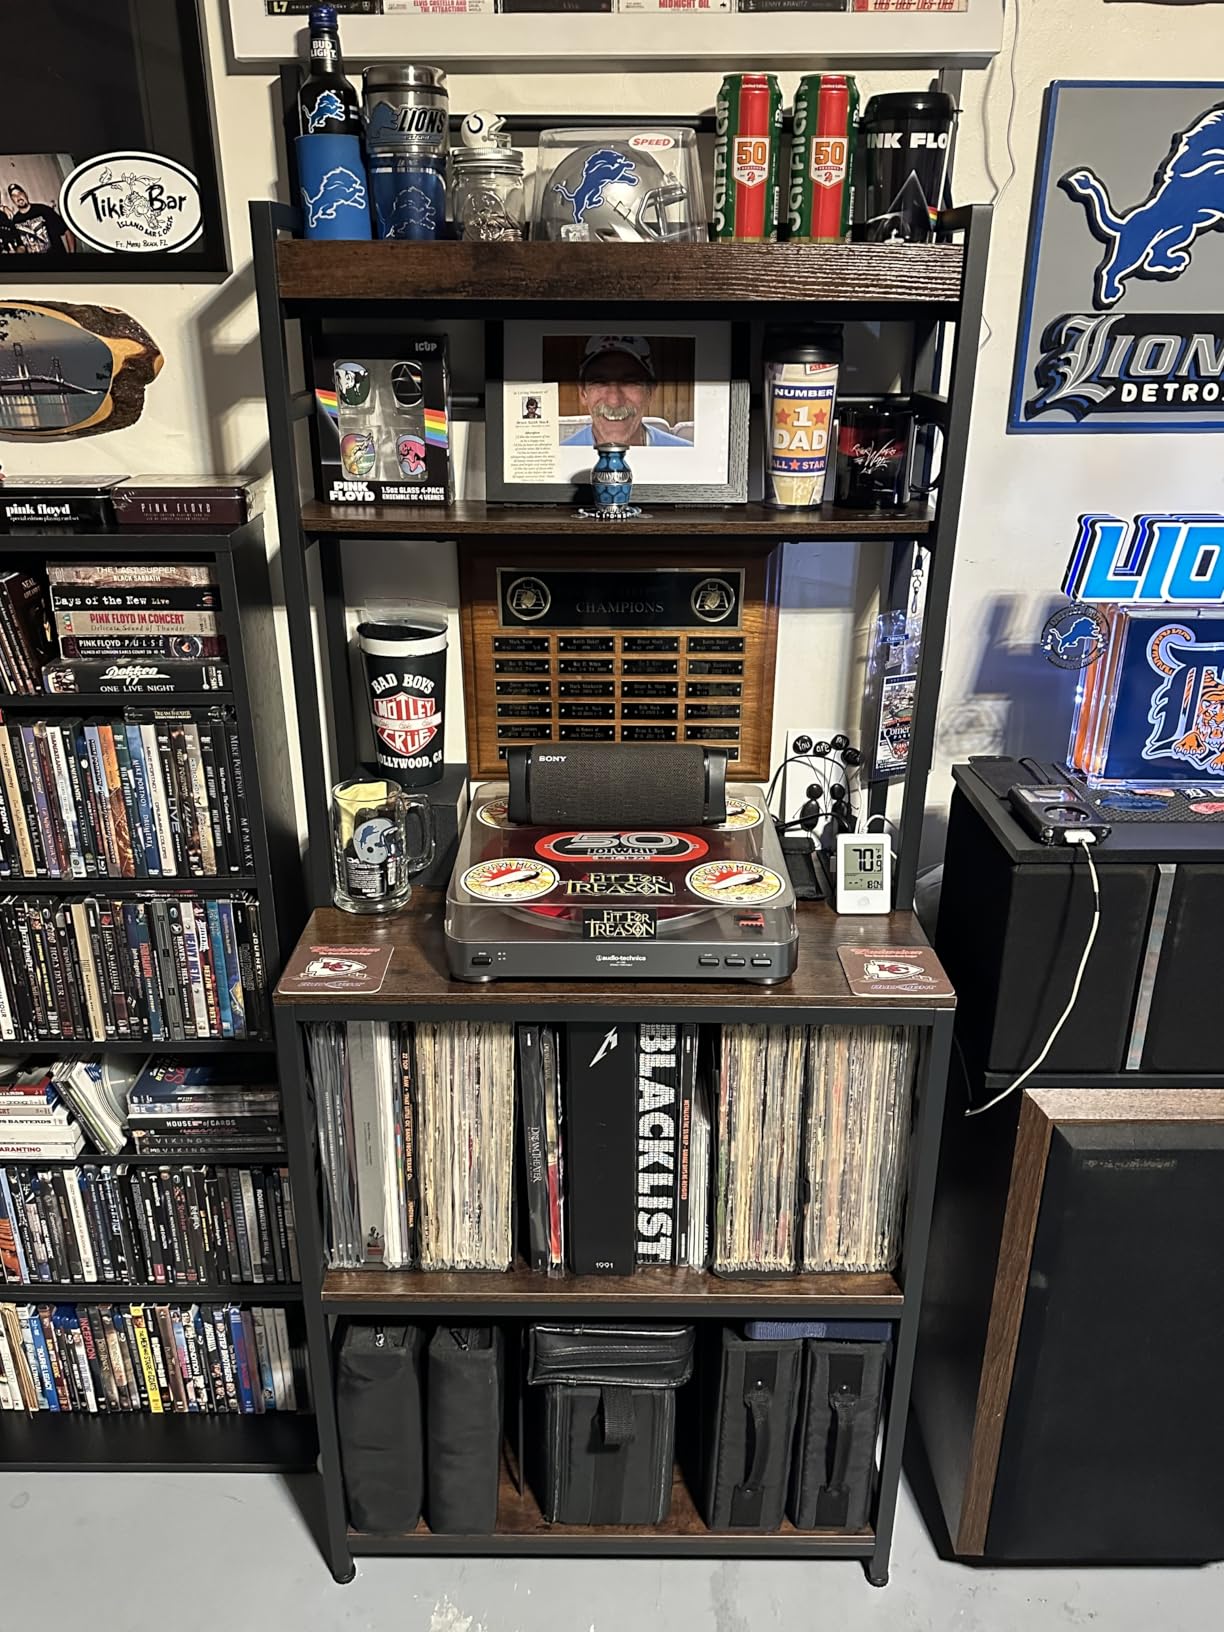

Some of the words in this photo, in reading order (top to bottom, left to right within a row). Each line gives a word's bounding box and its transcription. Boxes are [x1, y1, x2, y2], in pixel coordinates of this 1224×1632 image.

[273, 1, 287, 13] L7
[312, 40, 332, 49] BUD
[399, 108, 446, 133] LIONS
[633, 138, 672, 146] SPEED
[867, 133, 903, 149] INK
[910, 132, 948, 149] FLO
[737, 142, 766, 165] 50
[815, 142, 845, 165] 50
[80, 179, 124, 223] Tiki
[145, 184, 187, 213] Bar
[774, 389, 833, 398] NUMBER
[1121, 382, 1224, 402] DETRO
[792, 406, 812, 427] 1
[773, 429, 828, 451] DAD
[802, 460, 825, 468] STAR
[330, 490, 376, 502] FLOYD
[333, 480, 368, 491] PINK
[399, 486, 420, 494] GLASS
[5, 504, 36, 518] pink
[37, 503, 70, 517] floyd
[141, 503, 168, 512] PINK
[176, 503, 211, 512] FLOYD
[1074, 517, 1224, 602] LIO
[54, 596, 82, 606] Days
[86, 596, 98, 604] of
[102, 596, 122, 605] the
[126, 596, 147, 605] New
[576, 601, 664, 614] CHAMPIONS
[90, 614, 110, 624] PINK
[112, 614, 136, 624] FLOYD
[138, 614, 147, 624] IN
[149, 614, 184, 624] CONCERT
[97, 640, 120, 648] FLOYD
[371, 673, 398, 694] BAD
[402, 673, 434, 694] BOYS
[230, 735, 240, 757] MIKE
[1, 744, 11, 766] amazing
[6, 768, 15, 788] journey
[132, 759, 142, 775] MIKE
[68, 756, 82, 801] TRANSATLANTIC
[147, 762, 157, 792] PORTNOY
[232, 759, 244, 798] PORTNOY
[136, 777, 146, 807] PORTNOY
[0, 806, 10, 834] TOKYO
[168, 798, 180, 833] LIVE
[564, 832, 680, 849] 50
[558, 880, 676, 896] TREASON
[588, 873, 616, 884] FIT
[629, 873, 666, 884] FOR
[603, 910, 622, 924] FIT
[627, 911, 651, 924] FOR
[584, 919, 655, 938] TREASON
[177, 936, 186, 961] HEAVEN
[184, 933, 198, 958] HEAVY
[252, 932, 262, 976] JOURNEY
[50, 947, 59, 968] HOLY
[602, 954, 646, 962] audio-technica
[133, 960, 141, 977] Fogerty
[180, 968, 189, 985] HELL
[189, 960, 200, 985] METAL
[54, 970, 64, 995] DIVER
[203, 965, 212, 990] BELOW
[208, 1007, 217, 1024] BELT
[166, 1120, 192, 1128] HOUSE
[203, 1120, 210, 1128] of
[530, 1127, 541, 1151] DREAM
[637, 1024, 676, 1260] BLACKLIST
[532, 1151, 542, 1183] THEATER
[256, 1189, 265, 1208] ROGER
[259, 1209, 267, 1230] WATERS
[45, 1238, 53, 1259] MAGNETIC
[80, 1317, 96, 1360] INCEPTION
[142, 1337, 150, 1347] MEN
[204, 1323, 217, 1352] SPACEBALLS
[218, 1333, 228, 1349] STEP
[38, 1348, 48, 1369] BOURNE
[144, 1356, 153, 1370] STARE
[188, 1342, 199, 1375] RENDITION
[221, 1350, 233, 1382] BROTHERS
[31, 1364, 42, 1393] ULTIMATUM
[42, 1370, 52, 1390] LEGACY
[148, 1375, 157, 1391] GOATS
